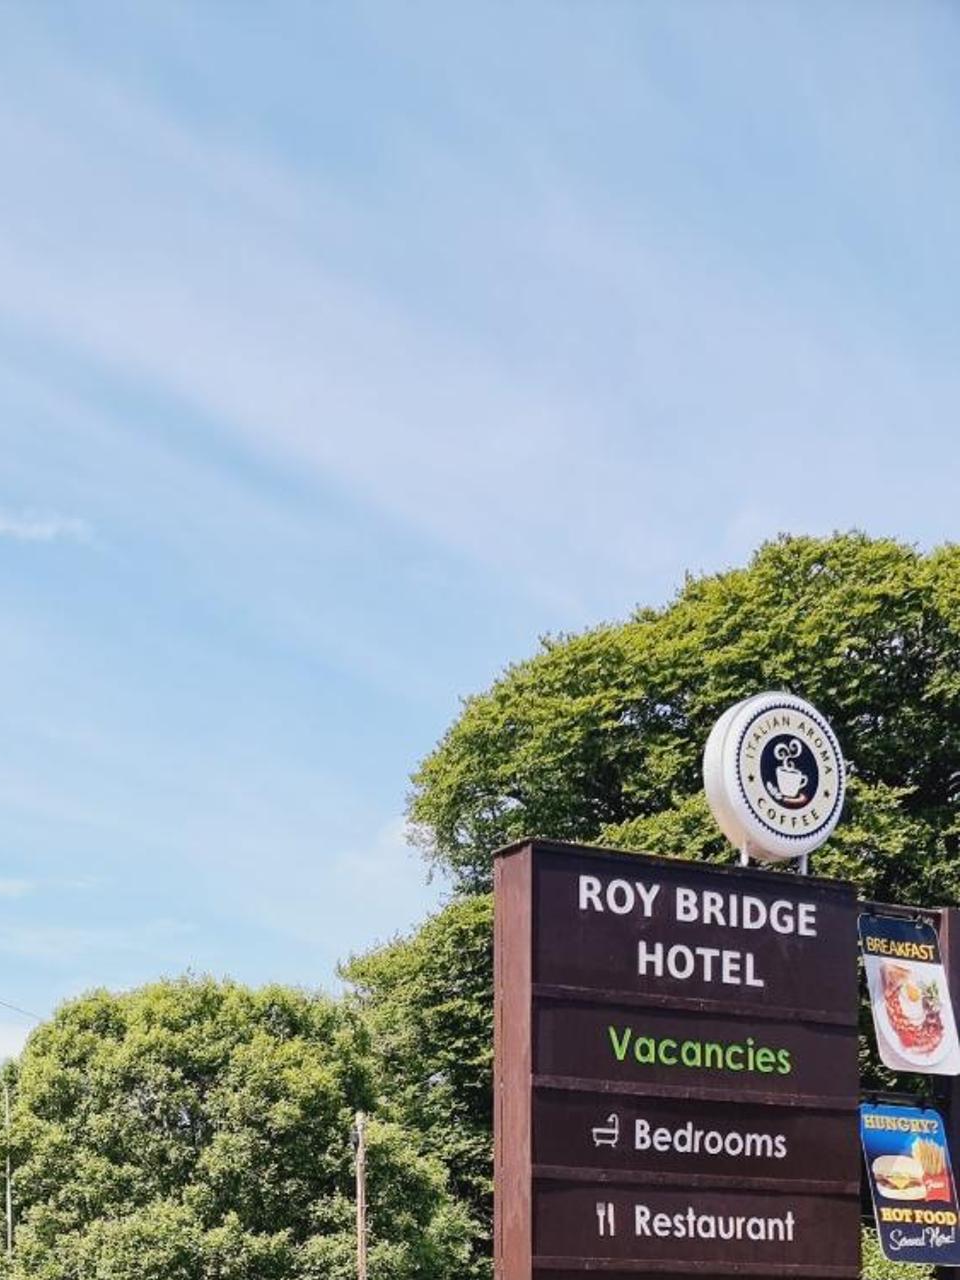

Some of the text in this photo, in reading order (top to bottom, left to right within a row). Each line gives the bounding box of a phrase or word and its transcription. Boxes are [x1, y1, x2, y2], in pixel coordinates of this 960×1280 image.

[746, 716, 833, 775] ITALIAN AROMA
[757, 798, 819, 828] COFFEE
[578, 874, 818, 938] ROY BRIDGE
[638, 940, 764, 988] HOTEL
[866, 936, 935, 961] BREAKFAST
[608, 1026, 792, 1075] Vacancies
[634, 1118, 788, 1159] Bedrooms
[863, 1114, 939, 1134] HUNGRY?
[634, 1203, 795, 1242] Restaurant
[880, 1207, 957, 1226] HOT FOOD
